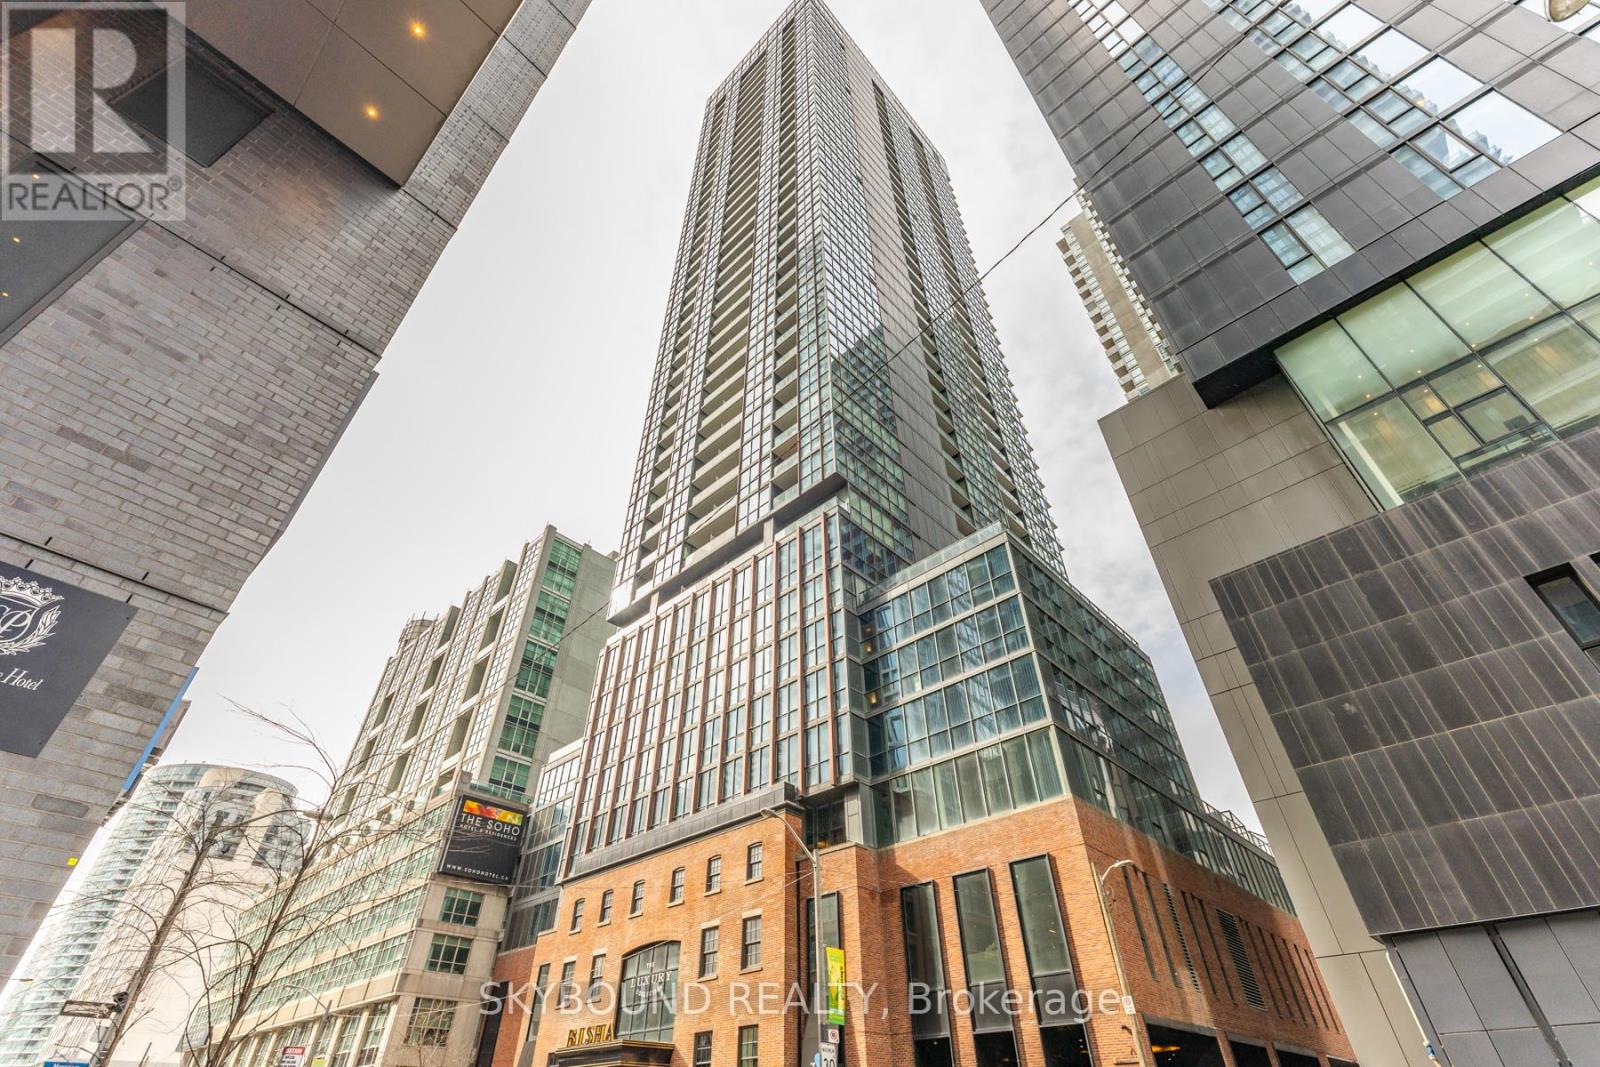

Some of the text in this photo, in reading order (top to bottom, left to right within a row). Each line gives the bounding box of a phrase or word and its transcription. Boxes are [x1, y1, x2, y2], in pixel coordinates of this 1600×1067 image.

[1, 668, 43, 691] Hotel
[461, 813, 520, 836] THE SOHO
[631, 971, 673, 988] LUXURY
[567, 1023, 615, 1048] BISHA
